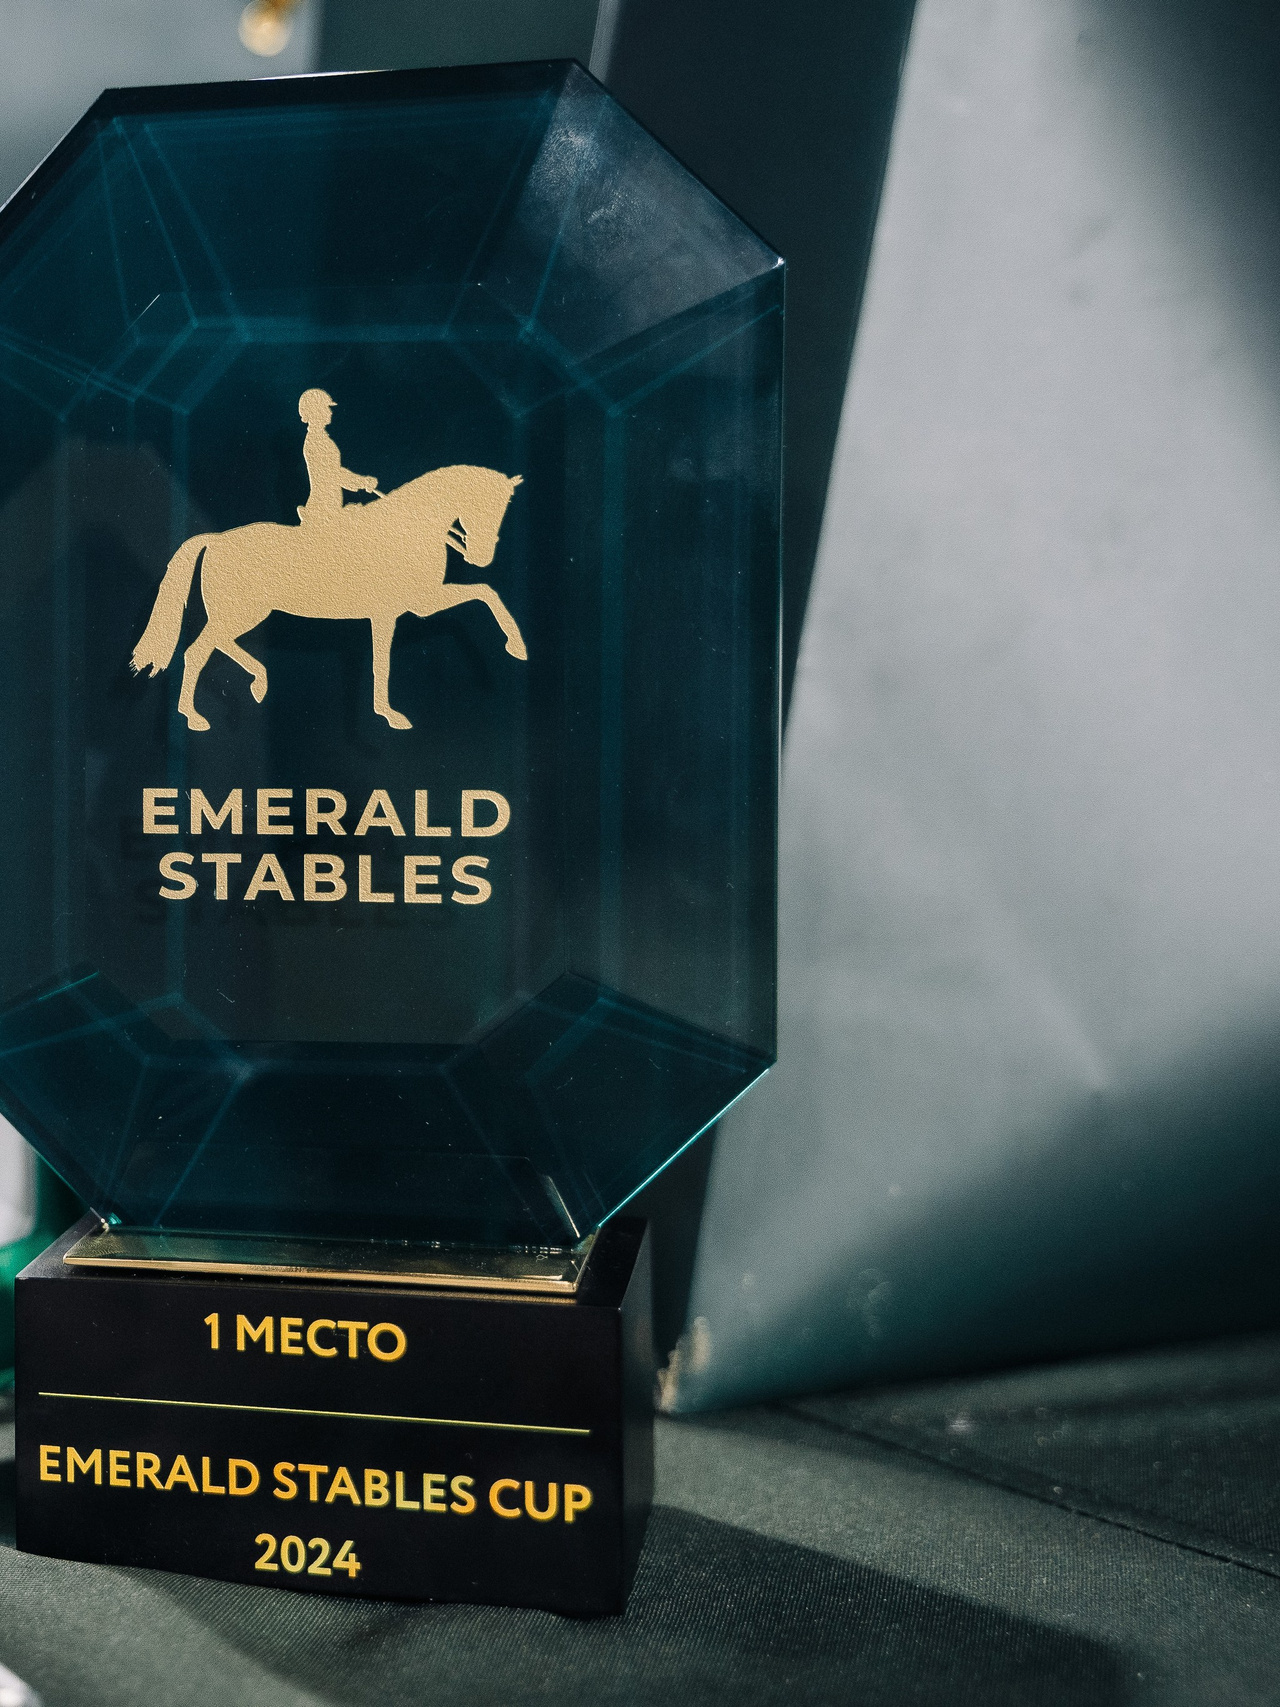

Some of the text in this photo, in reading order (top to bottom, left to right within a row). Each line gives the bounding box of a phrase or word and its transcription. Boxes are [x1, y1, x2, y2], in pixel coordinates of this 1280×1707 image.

[143, 788, 511, 837] EMERALD
[158, 852, 493, 905] STABLES
[203, 1312, 219, 1350] 1
[39, 1444, 593, 1523] EMERALD STABLES CUP
[254, 1532, 362, 1579] 2024
